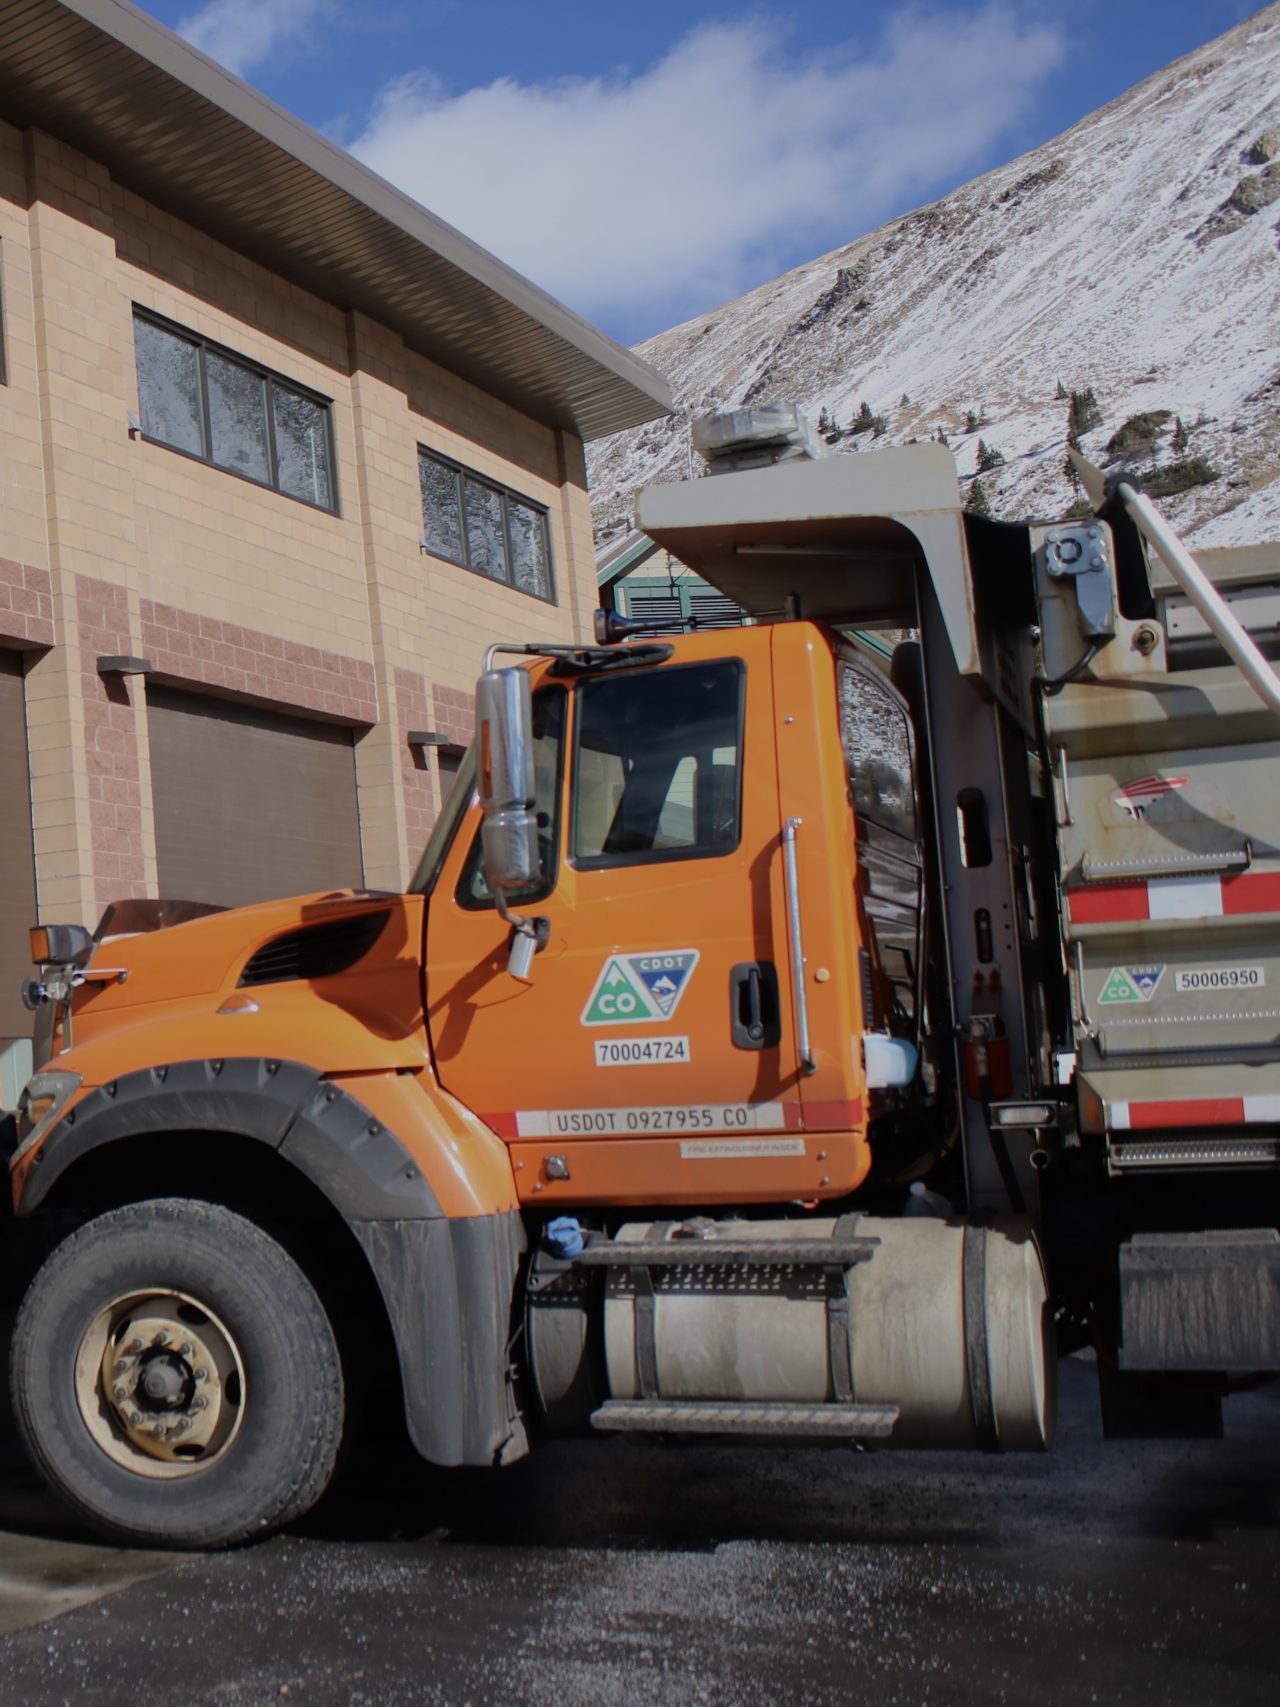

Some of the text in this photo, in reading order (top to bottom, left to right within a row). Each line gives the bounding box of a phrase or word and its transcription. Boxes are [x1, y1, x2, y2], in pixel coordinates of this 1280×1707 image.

[640, 957, 684, 970] CDOT
[1181, 969, 1259, 988] 50006950
[1107, 986, 1130, 998] CO
[598, 992, 637, 1014] CO
[599, 1041, 685, 1062] 70004724
[557, 1107, 747, 1132] USDOT 0927955 CO
[687, 1145, 706, 1154] FIRE
